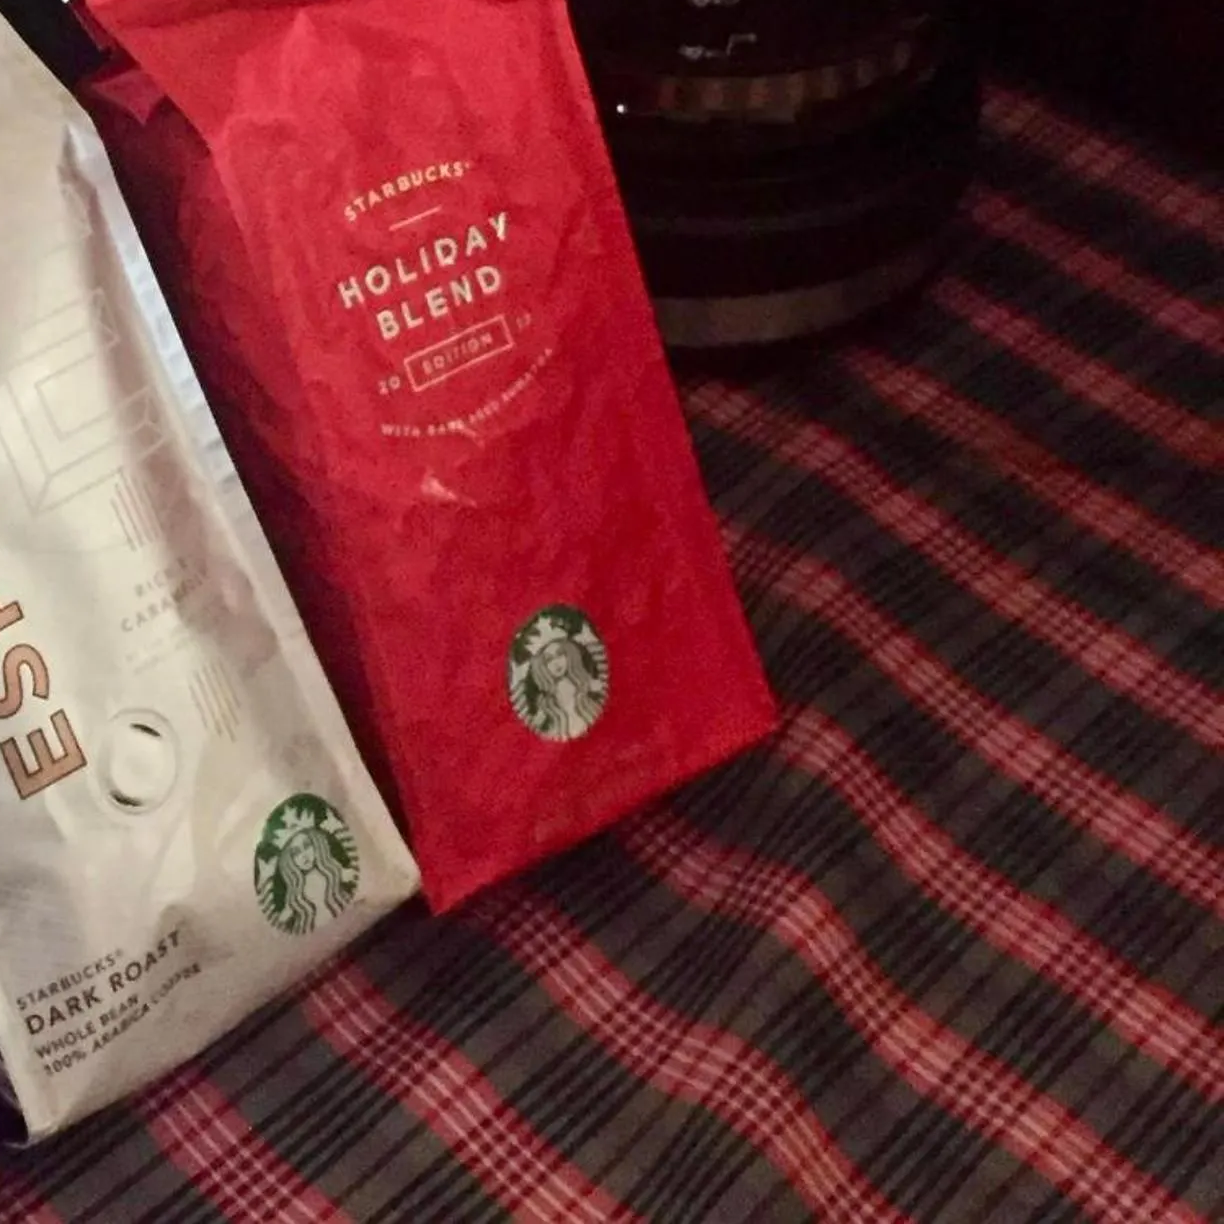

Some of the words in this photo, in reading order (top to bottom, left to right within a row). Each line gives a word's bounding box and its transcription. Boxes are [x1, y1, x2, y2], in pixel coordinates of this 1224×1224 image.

[337, 211, 510, 310] HOLIDAY
[376, 265, 503, 341] BLEND
[421, 332, 494, 376] EDITION
[25, 986, 102, 1036] DARK
[108, 929, 181, 993] ROAST
[34, 1020, 97, 1059] WHOLE
[99, 993, 139, 1027] BEAN
[43, 1049, 88, 1077] 100%
[92, 1002, 151, 1053] ARABICA
